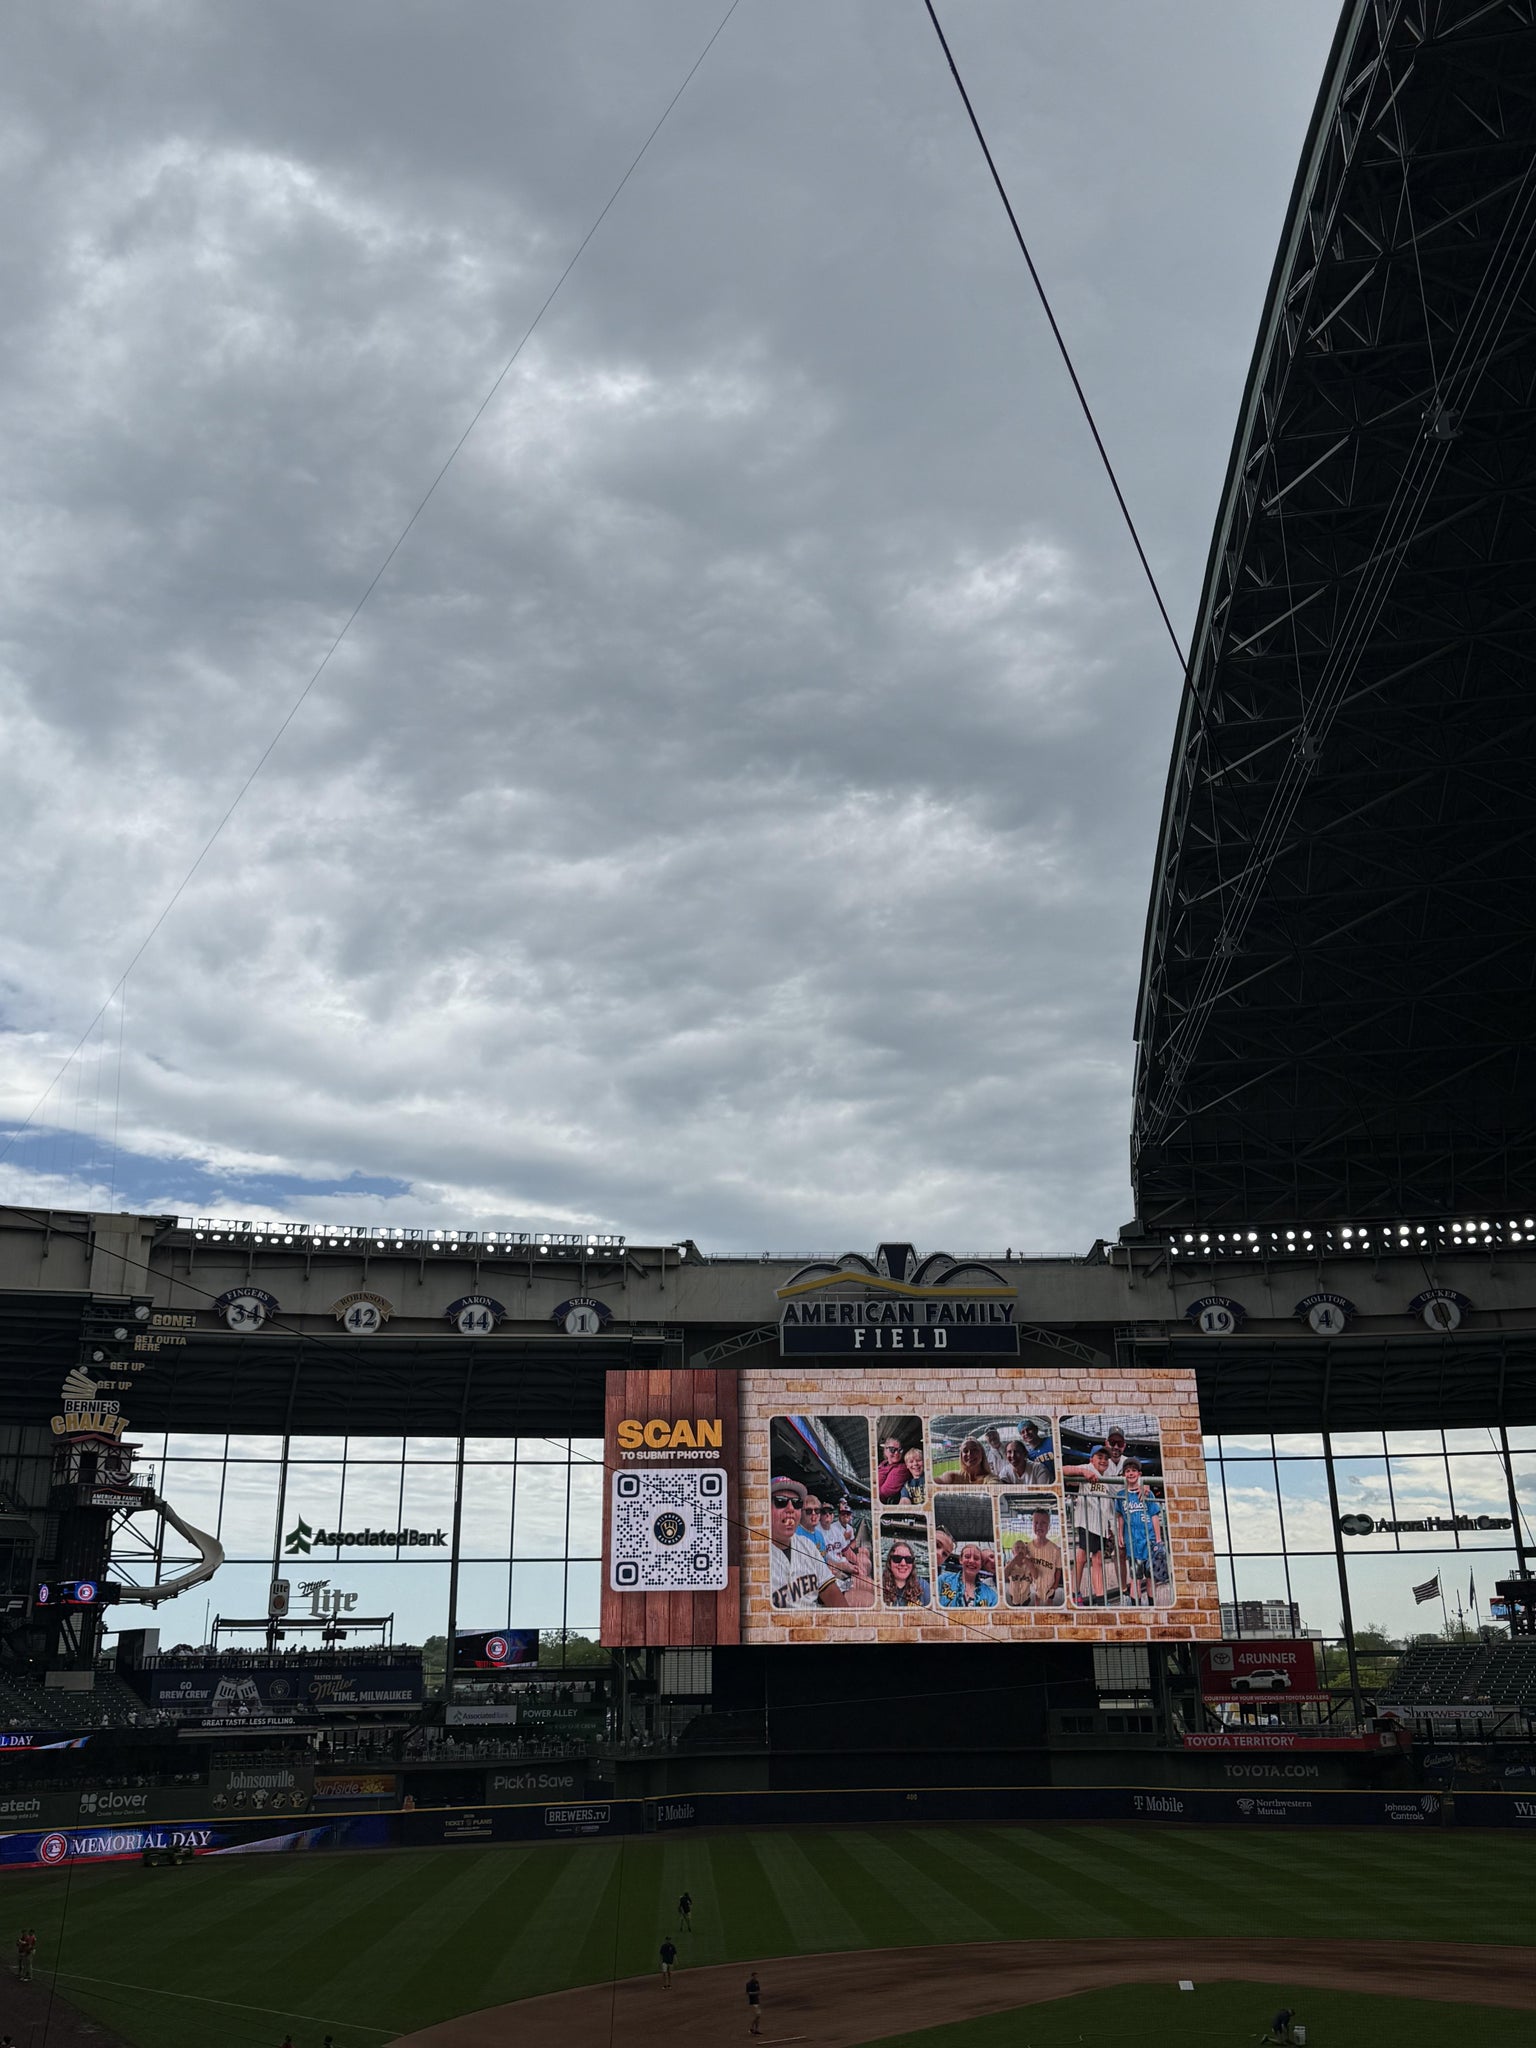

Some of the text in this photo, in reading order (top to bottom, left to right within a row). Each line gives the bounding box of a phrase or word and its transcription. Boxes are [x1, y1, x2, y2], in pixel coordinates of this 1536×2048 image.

[227, 1288, 269, 1301] FINGERS
[341, 1293, 385, 1306] ROBINSON
[461, 1296, 493, 1306] AARON
[1302, 1294, 1346, 1307] MOLITOR
[1419, 1289, 1458, 1302] UECKER
[568, 1297, 597, 1308] SELIG
[1200, 1297, 1231, 1307] YOUNT
[231, 1304, 261, 1325] 34
[349, 1308, 377, 1328] 42
[783, 1303, 1016, 1322] AMERICAN FAMILY
[1318, 1309, 1332, 1329] 4
[152, 1314, 197, 1328] GONE!
[462, 1311, 489, 1331] 44
[577, 1314, 589, 1333] 1
[1204, 1312, 1231, 1332] 19
[135, 1334, 188, 1345] GET OUTTA
[854, 1328, 947, 1349] FIELD
[134, 1343, 161, 1352] HERE
[109, 1361, 146, 1371] GET UP
[97, 1380, 133, 1391] GET UP
[64, 1400, 121, 1414] BERNIE'S
[50, 1411, 131, 1436] CHALET
[617, 1419, 723, 1450] SCAN
[620, 1450, 720, 1460] TO SUBMIT PHOTOS
[1378, 1515, 1512, 1532] Aurora Health Care
[312, 1528, 449, 1547] AssociatedBank
[272, 1583, 289, 1595] Lite
[298, 1579, 332, 1598] Miller
[308, 1588, 359, 1619] Lite
[1238, 1652, 1297, 1664] 4RUNNER
[180, 1681, 192, 1690] GO
[308, 1678, 358, 1700] Miller
[160, 1690, 209, 1699] BREW CREW
[333, 1690, 413, 1702] TIME, MILWAUKEE
[522, 1708, 578, 1718] POWER ALLEY
[225, 1718, 248, 1726] TASTE.
[267, 1717, 296, 1725] FILLING.
[9, 1735, 34, 1746] DAY
[1186, 1736, 1295, 1746] TOYOTA TERRITORY
[1224, 1764, 1319, 1777] TOYOTA.COM
[227, 1769, 295, 1790] Johnsonville
[493, 1775, 524, 1790] Pick
[538, 1773, 574, 1788] Save
[314, 1780, 359, 1797] Surfside
[0, 1798, 41, 1813] atech
[98, 1791, 149, 1809] clover
[1256, 1799, 1312, 1809] Northwestern
[1257, 1807, 1287, 1816] Mutual
[1384, 1802, 1417, 1812] Johnson
[549, 1809, 607, 1823] BREWERS.TV
[1390, 1810, 1425, 1820] Controls
[445, 1818, 493, 1827] TICKET PLANS
[71, 1830, 212, 1854] MEMORIAL DAY
